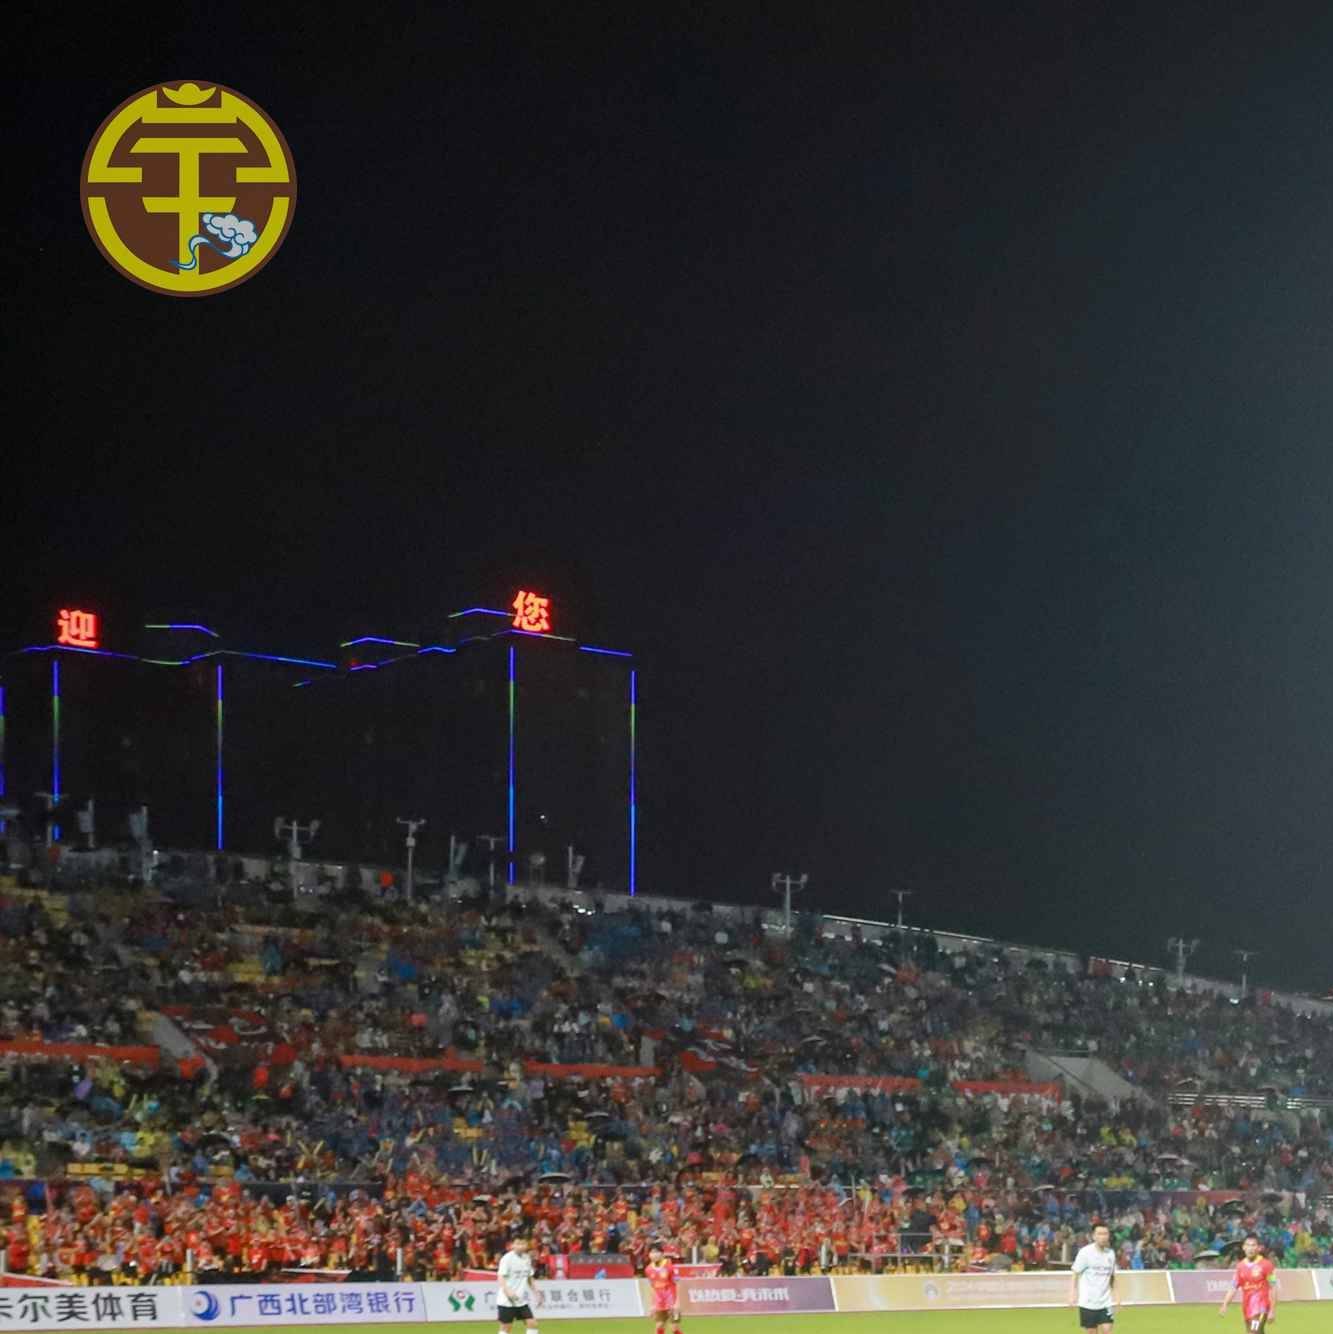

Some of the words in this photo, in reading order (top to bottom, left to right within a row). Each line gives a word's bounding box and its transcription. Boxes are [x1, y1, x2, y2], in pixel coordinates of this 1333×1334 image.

[57, 608, 98, 648] 迎
[512, 590, 551, 632] 您
[229, 1291, 416, 1317] 广西北部湾银行
